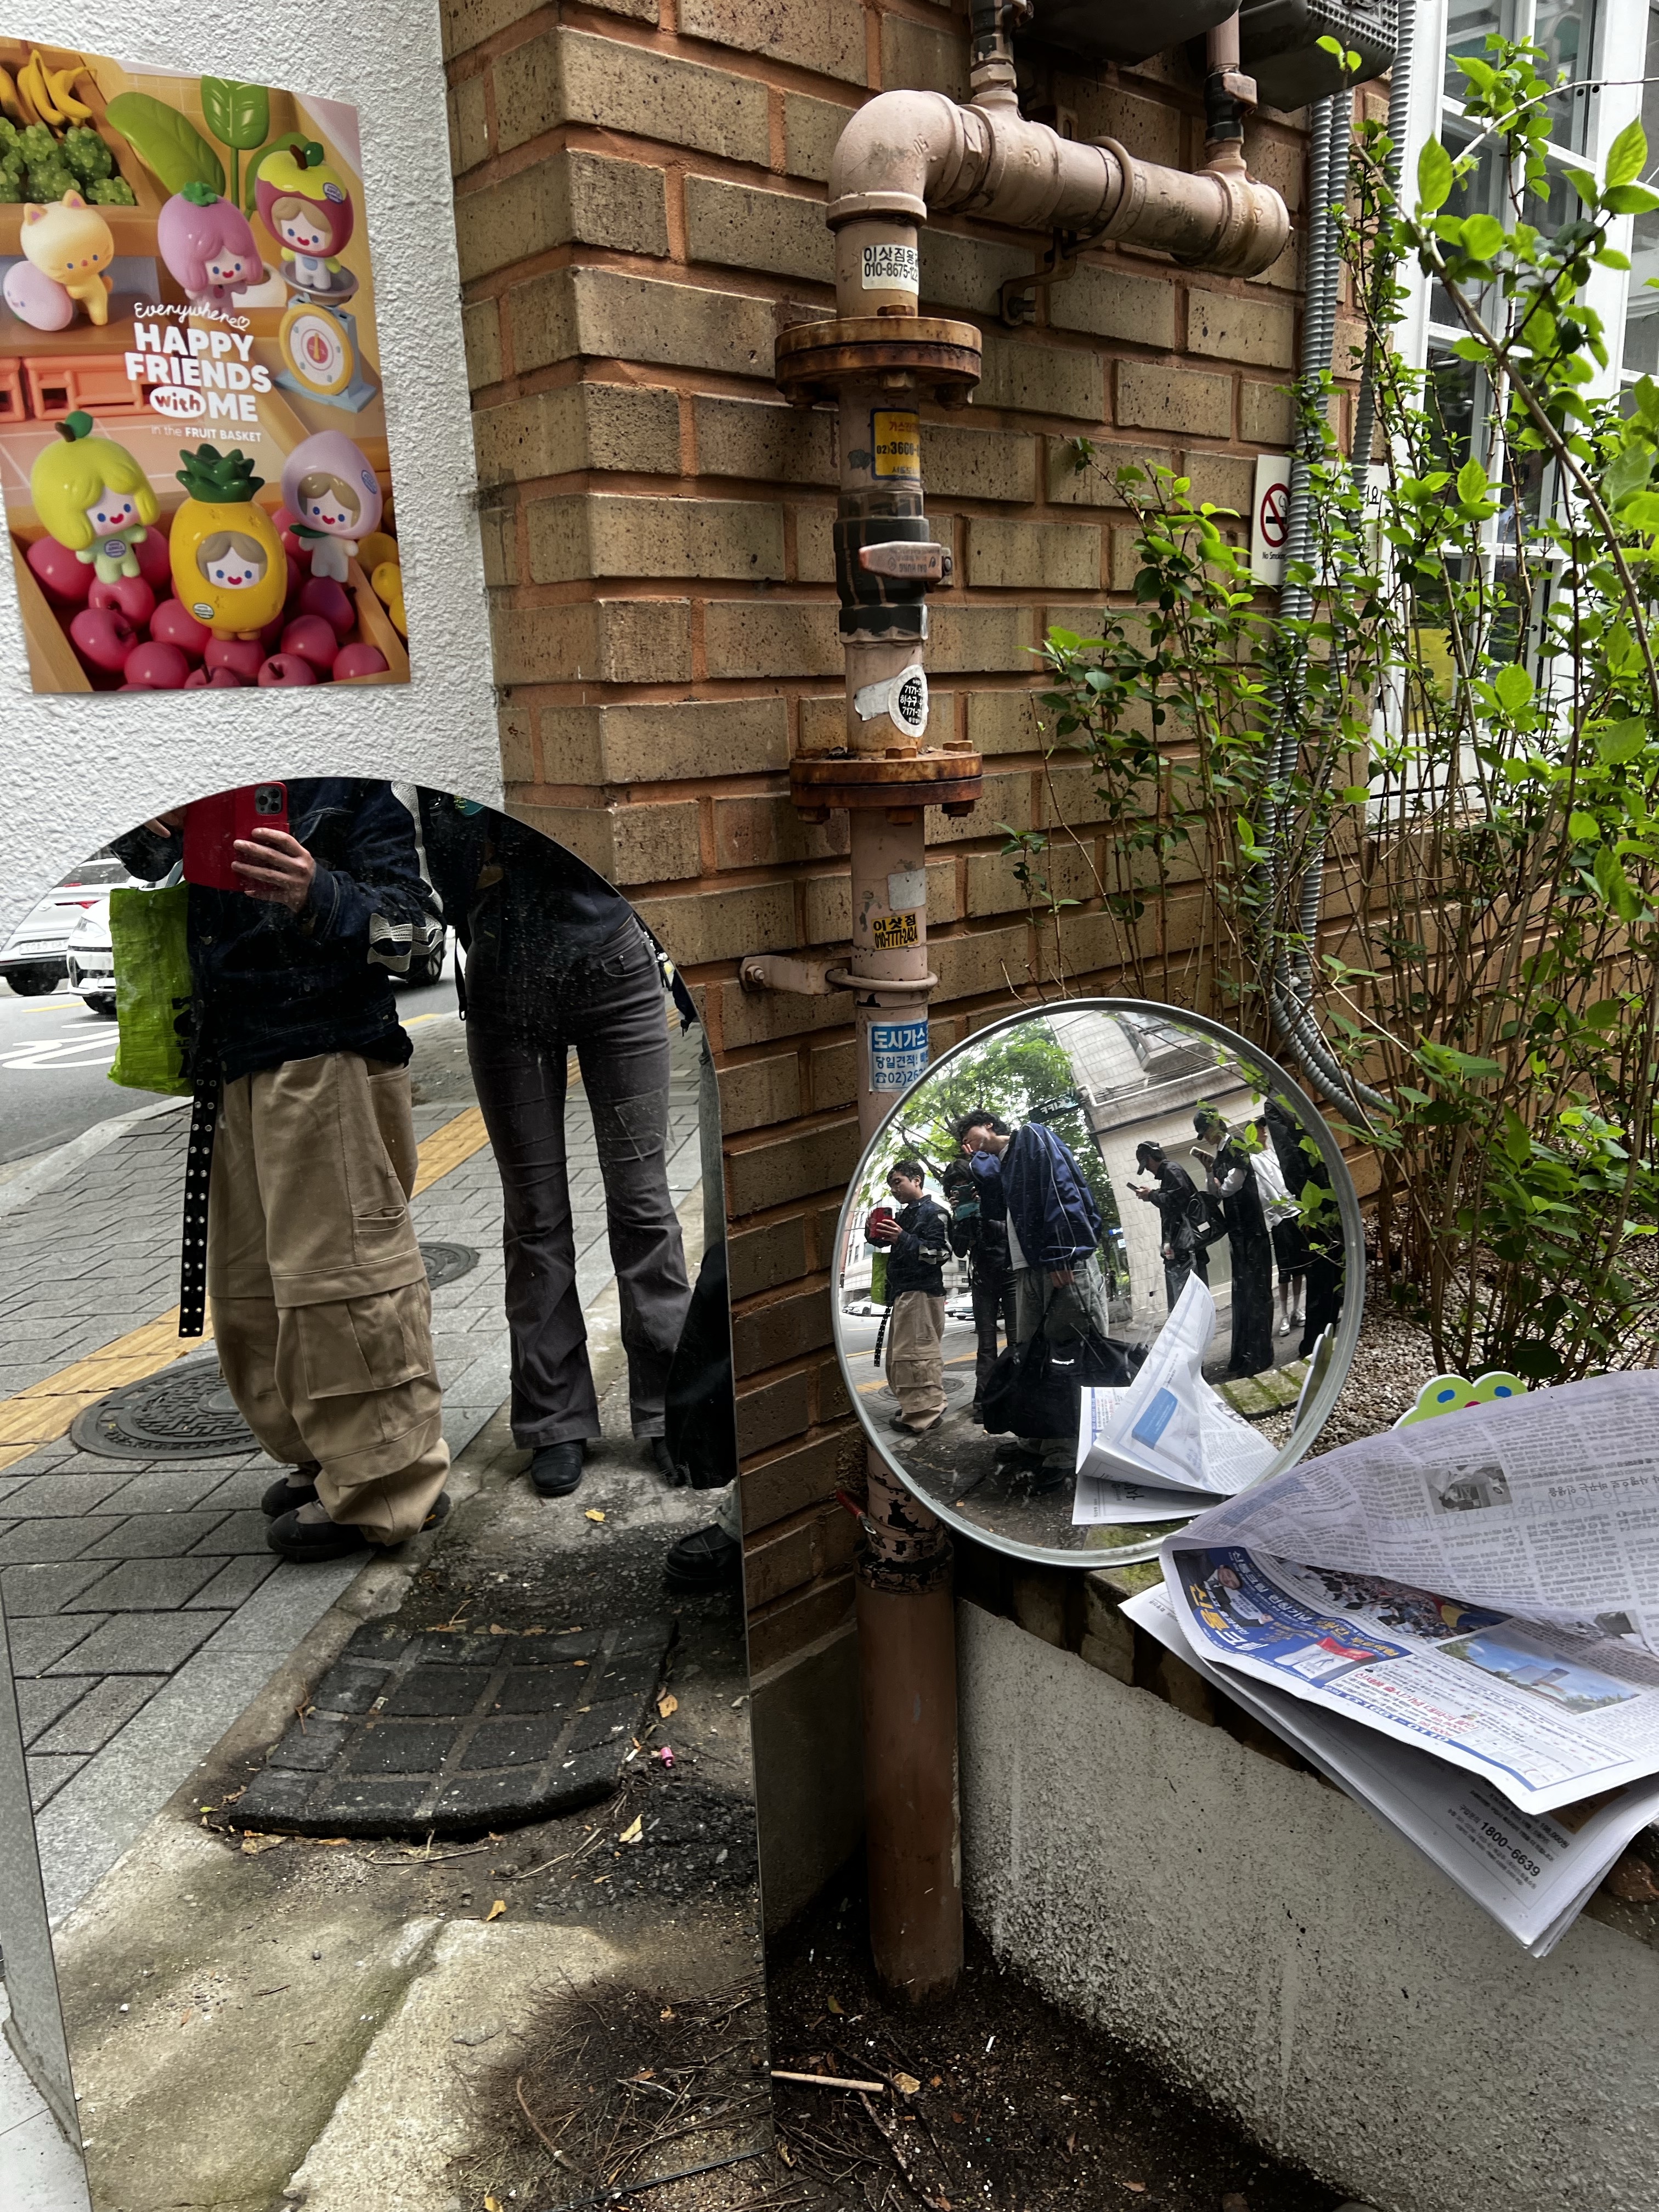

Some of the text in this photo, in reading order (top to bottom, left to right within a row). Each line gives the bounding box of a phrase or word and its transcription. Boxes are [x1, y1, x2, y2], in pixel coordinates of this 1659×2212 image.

[865, 262, 918, 281] 010-8675-
[134, 302, 238, 328] Everywhere
[134, 322, 254, 362] HAPPY
[125, 352, 272, 393] FRIENDS
[155, 391, 258, 422] with ME
[151, 425, 262, 443] in the FRUIT BASKET
[873, 913, 916, 931] 이삿짐
[874, 1025, 928, 1049] 도시가스
[888, 1068, 926, 1086] 02)26
[1480, 1821, 1541, 1876] 1800-6639
